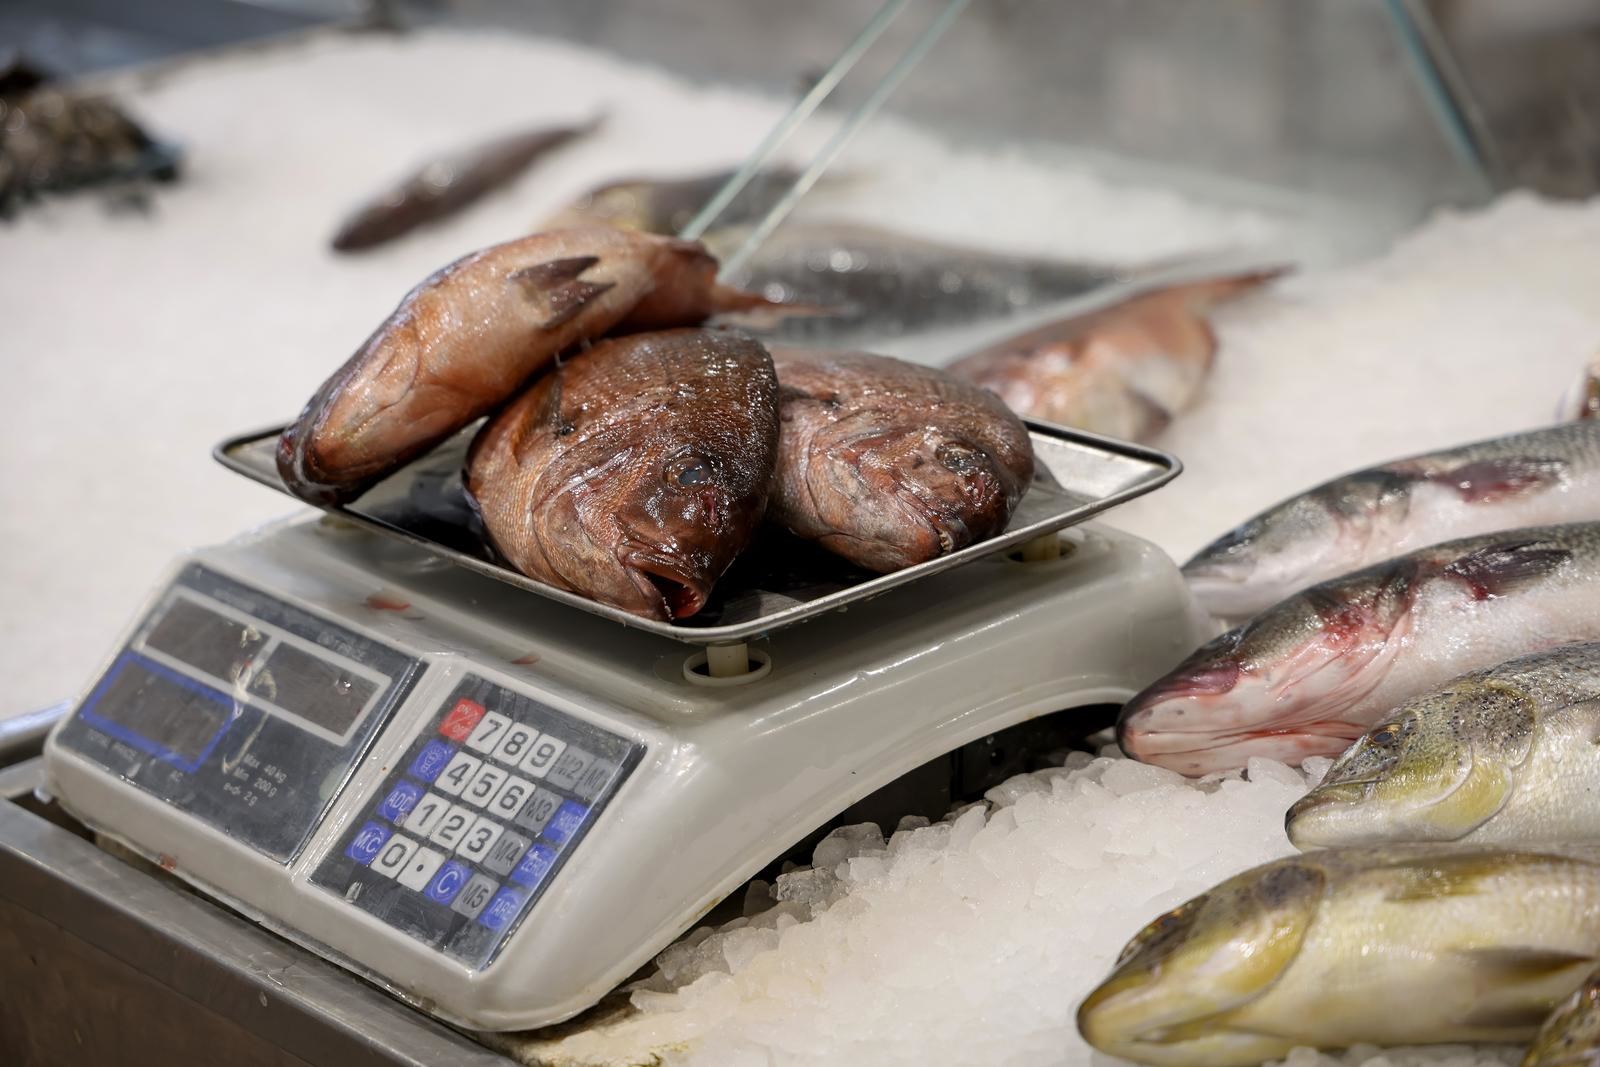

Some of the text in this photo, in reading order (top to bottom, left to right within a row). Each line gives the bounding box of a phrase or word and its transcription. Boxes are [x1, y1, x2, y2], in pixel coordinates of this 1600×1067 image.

[477, 719, 503, 742] 7
[503, 731, 529, 756] 8
[529, 743, 556, 768] 9
[447, 762, 525, 810] 4 5 6
[526, 797, 553, 822] M3
[417, 803, 493, 853] 1 2 3
[381, 843, 407, 868] 0
[494, 839, 522, 867] M4
[437, 870, 458, 894] C
[461, 882, 490, 909] M5
